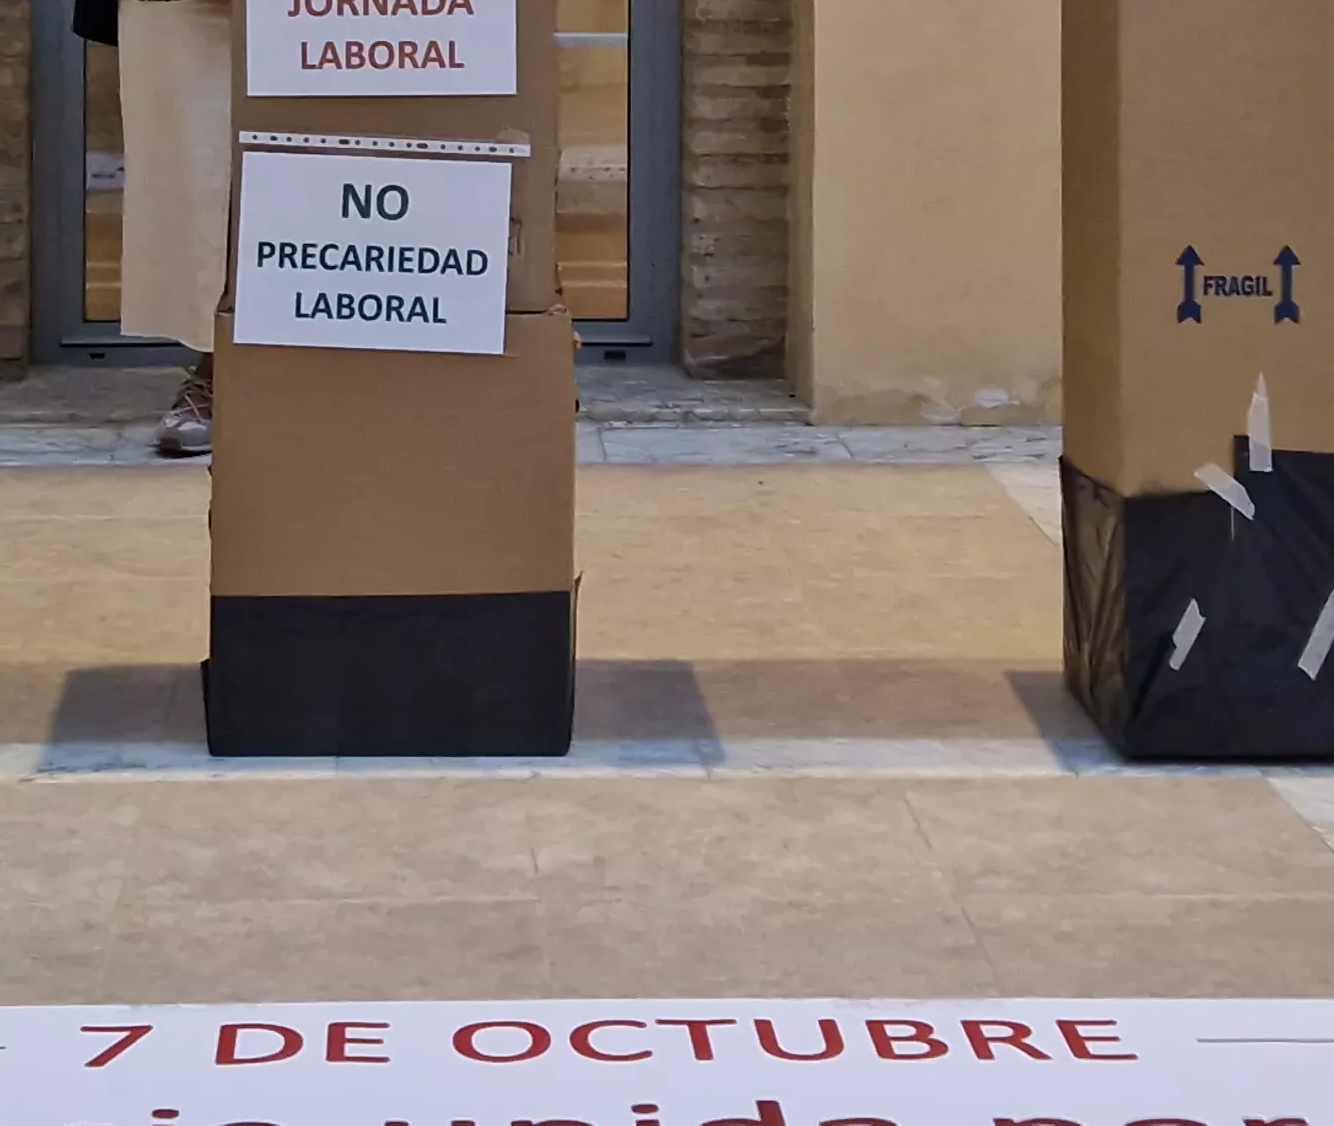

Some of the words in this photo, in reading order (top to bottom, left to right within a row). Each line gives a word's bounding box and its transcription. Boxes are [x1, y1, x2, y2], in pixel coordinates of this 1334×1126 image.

[300, 40, 466, 70] LABORAL
[341, 183, 410, 221] NO
[257, 241, 489, 276] PRECARIEDAD
[1203, 275, 1273, 297] FRAGIL
[294, 291, 447, 324] LABORAL
[79, 1024, 154, 1068] 7
[214, 1021, 391, 1066] DE
[452, 1019, 1139, 1063] OCTUBRE
